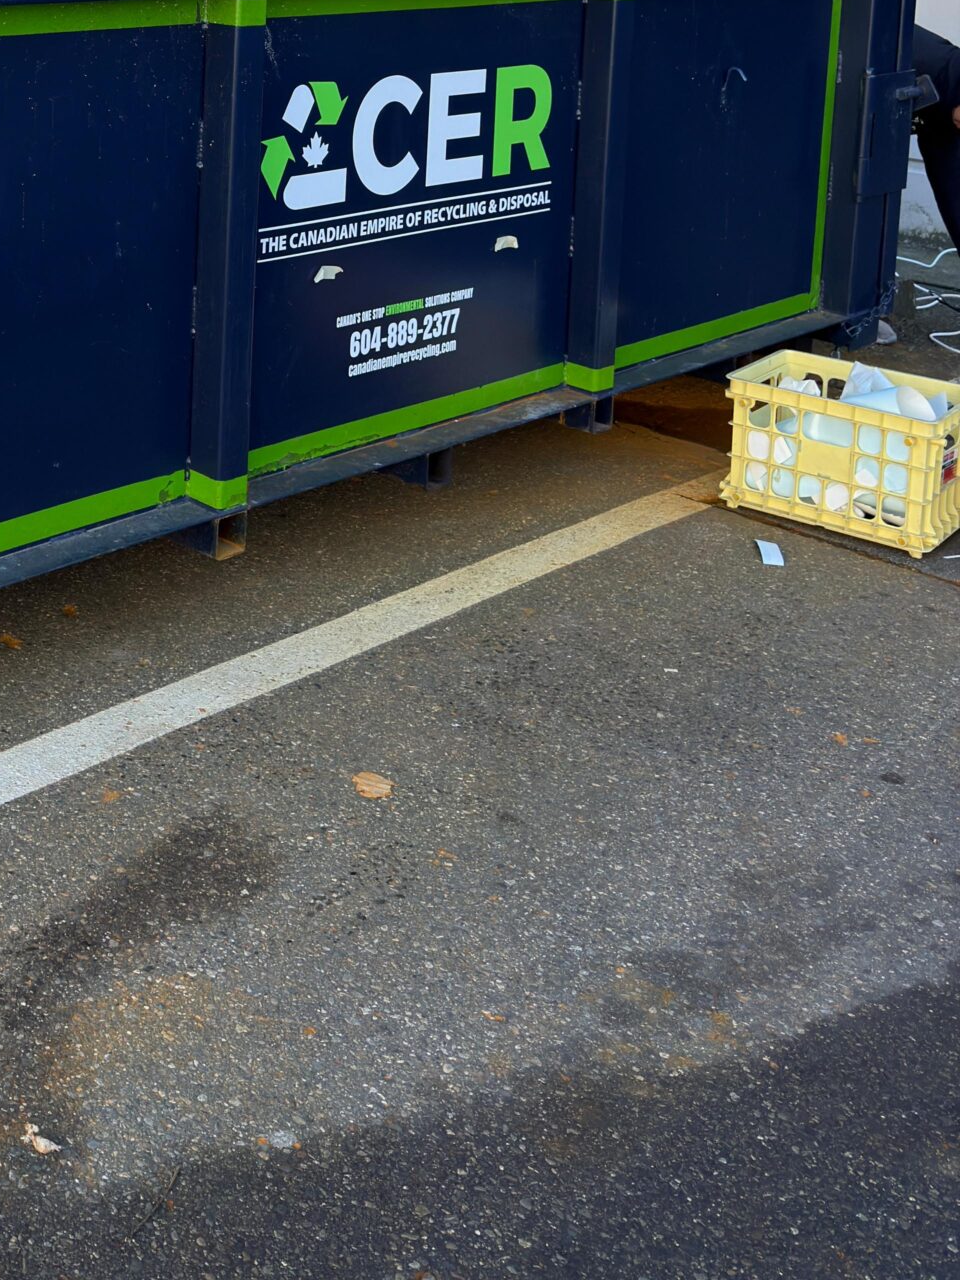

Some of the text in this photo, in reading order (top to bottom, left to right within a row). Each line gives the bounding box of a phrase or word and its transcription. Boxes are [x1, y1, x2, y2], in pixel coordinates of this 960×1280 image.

[352, 64, 553, 196] CER
[260, 190, 551, 254] THE CANADIAN EMPIRE OF RECYCLING & DISPOSAL
[336, 287, 474, 328] CANADA'S ONE STOP ENVIRONMENTAL SOLUTIONS COMPANY
[349, 308, 460, 358] 604-889-2377
[348, 340, 457, 377] canadianempirerecycling.com
